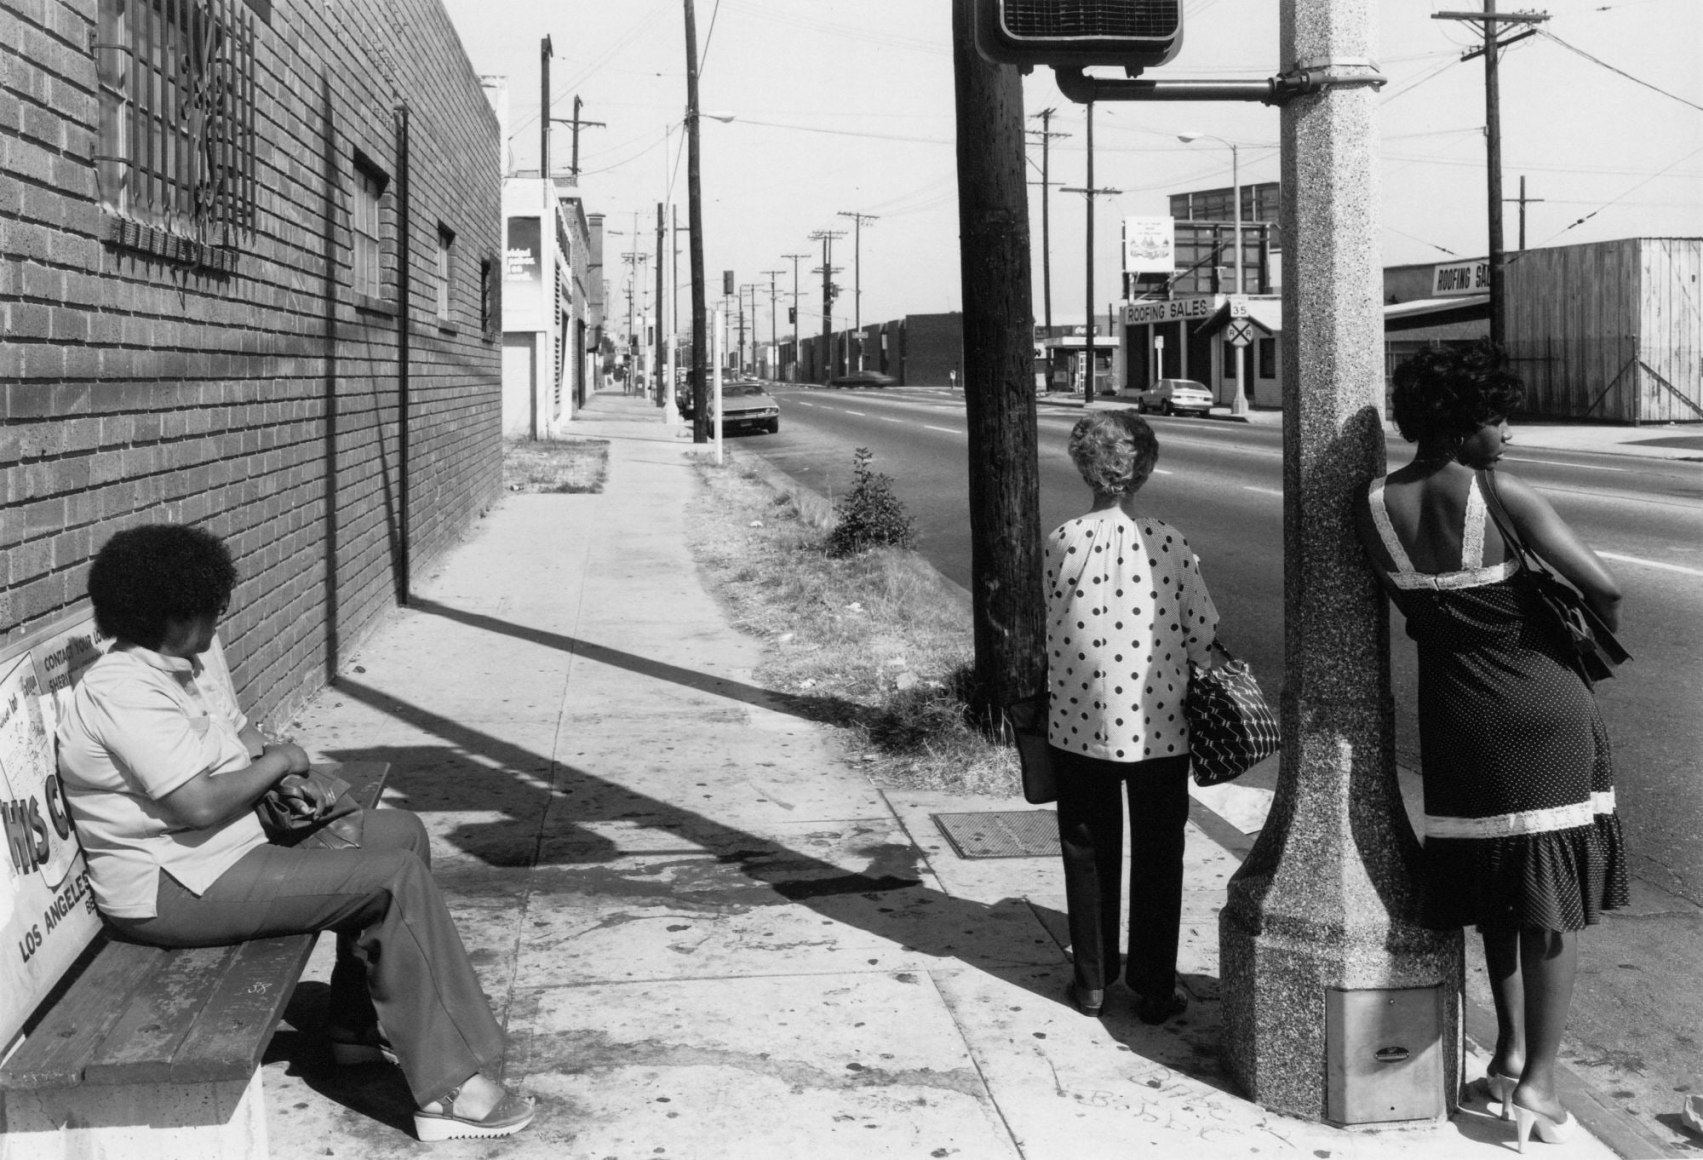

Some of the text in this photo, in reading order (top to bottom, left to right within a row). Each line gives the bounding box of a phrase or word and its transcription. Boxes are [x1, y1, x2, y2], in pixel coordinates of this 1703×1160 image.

[1437, 267, 1470, 291] ROOFING
[1170, 300, 1207, 318] SALES
[1233, 306, 1247, 315] 35
[44, 643, 74, 671] CONTACT
[0, 794, 50, 875] HIS
[19, 870, 91, 963] LOS ANGELES
